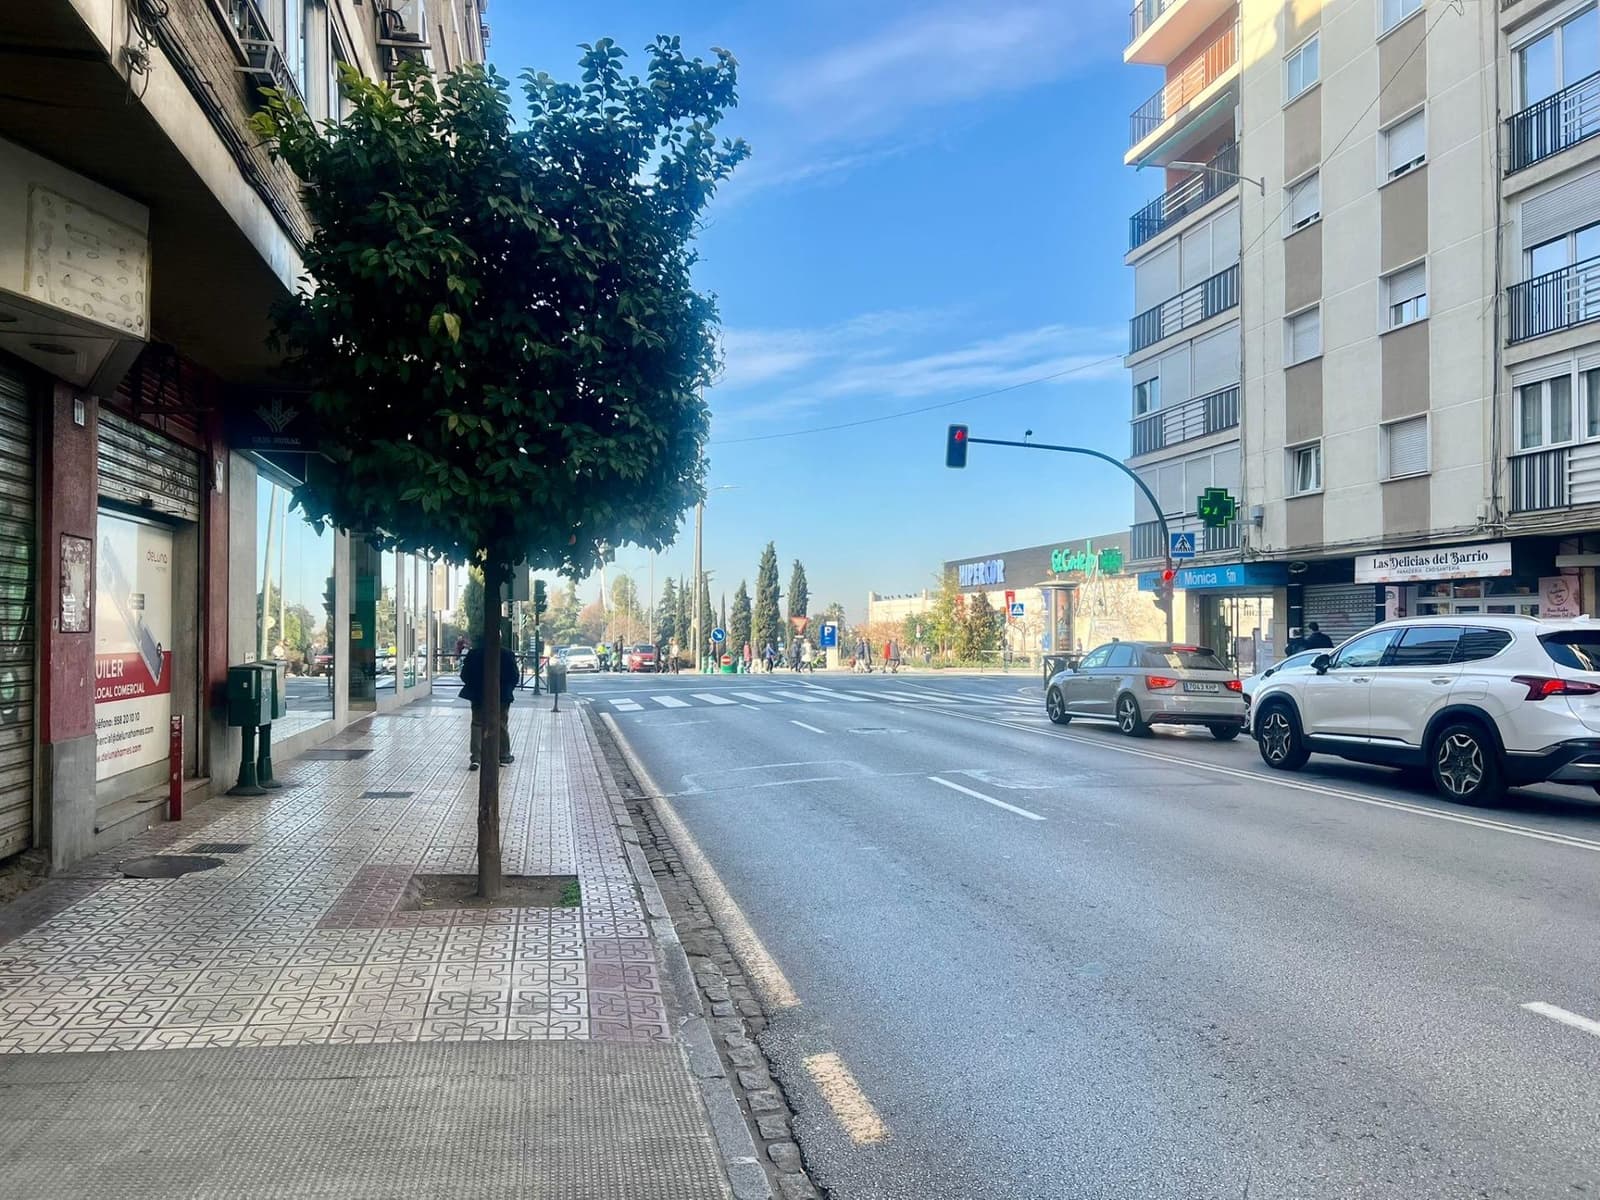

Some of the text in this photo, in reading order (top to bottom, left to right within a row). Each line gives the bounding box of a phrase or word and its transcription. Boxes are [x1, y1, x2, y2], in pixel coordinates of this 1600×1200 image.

[1373, 550, 1488, 570] Las Delicias del Barrio
[958, 559, 1005, 587] HIPERCOR
[824, 626, 833, 637] P
[95, 659, 124, 679] UILER
[113, 682, 145, 697] COMERCIAL
